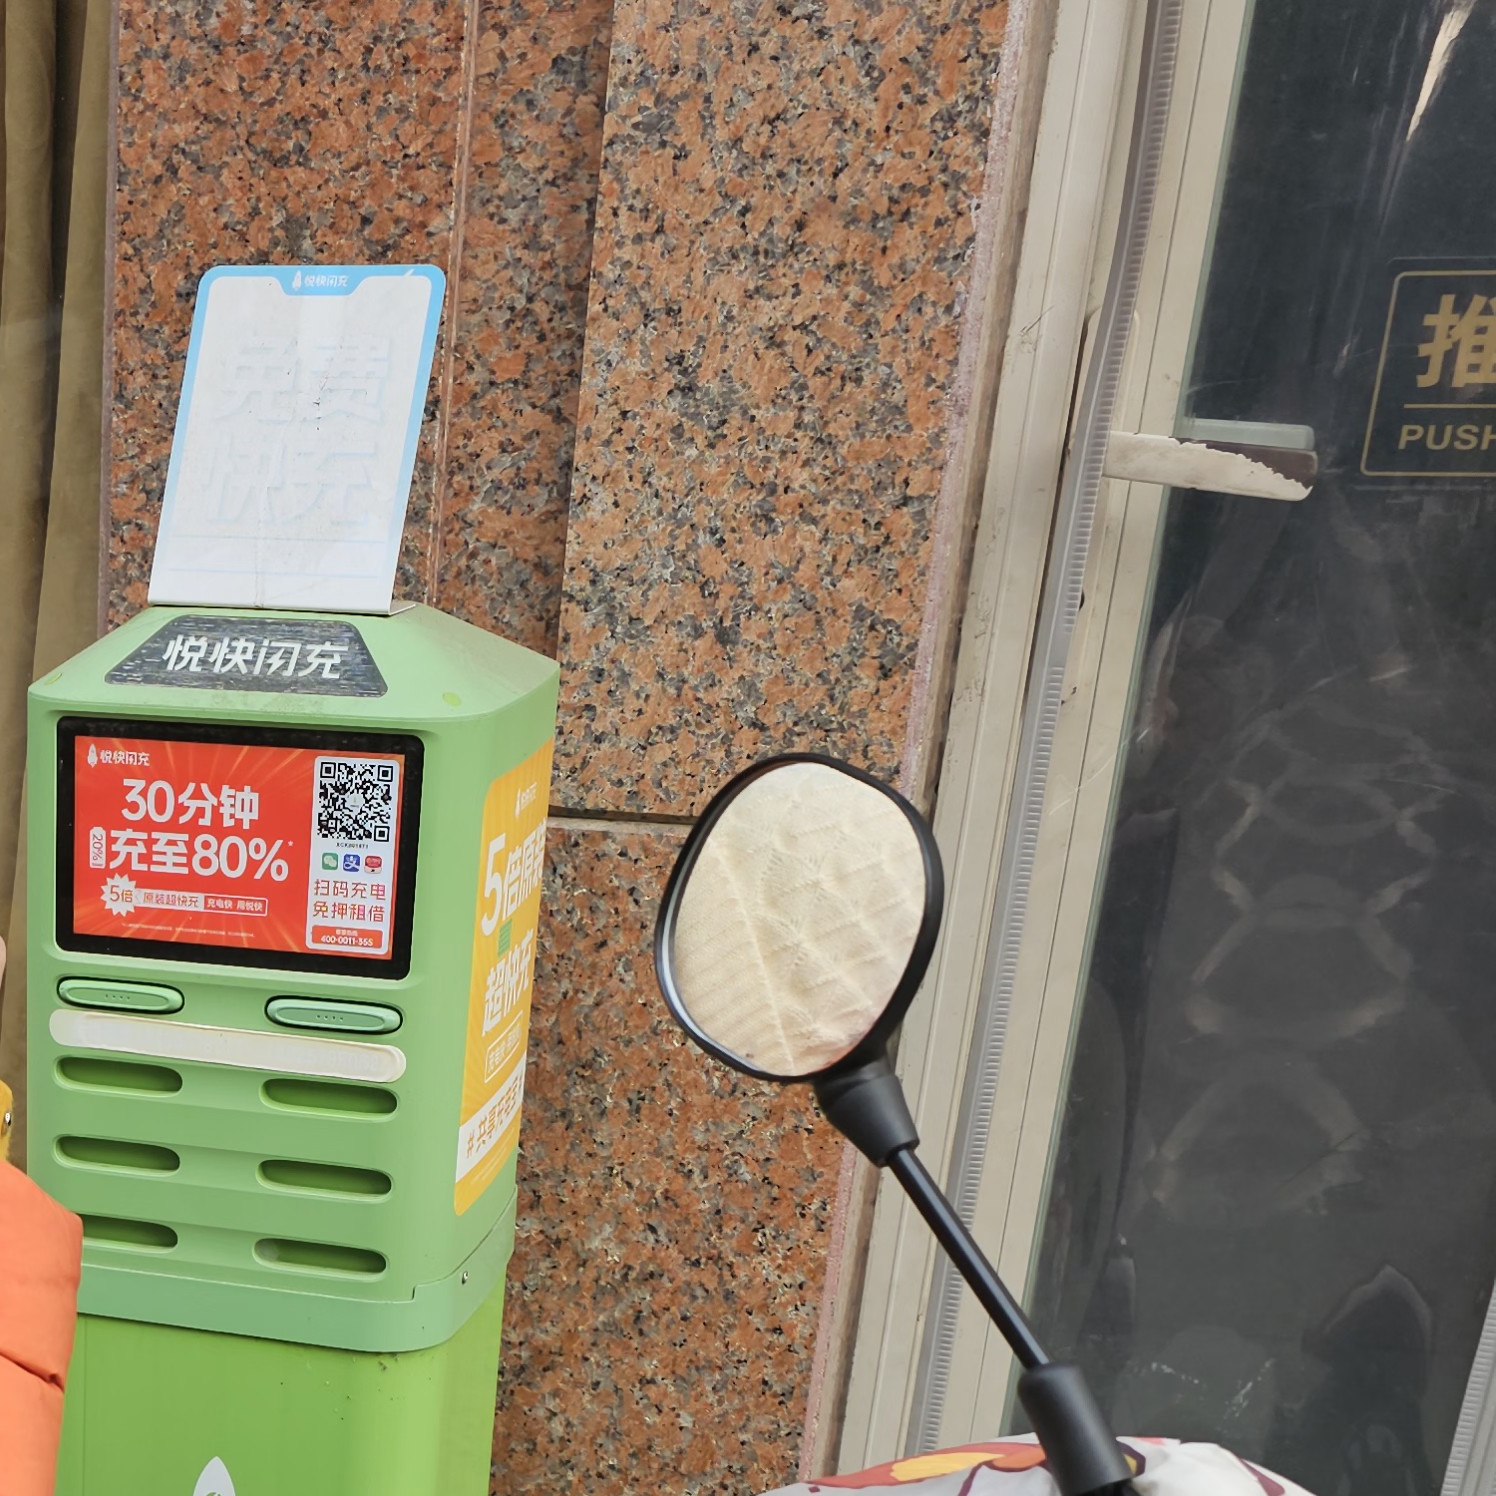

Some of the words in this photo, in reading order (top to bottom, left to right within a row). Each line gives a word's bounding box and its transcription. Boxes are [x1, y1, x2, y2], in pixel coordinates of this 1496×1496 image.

[162, 634, 349, 679] 悦快闪充
[120, 778, 260, 830] 30分钟
[109, 884, 134, 903] 5倍
[313, 878, 386, 901] 扫码充电
[312, 900, 385, 923] 免押租借
